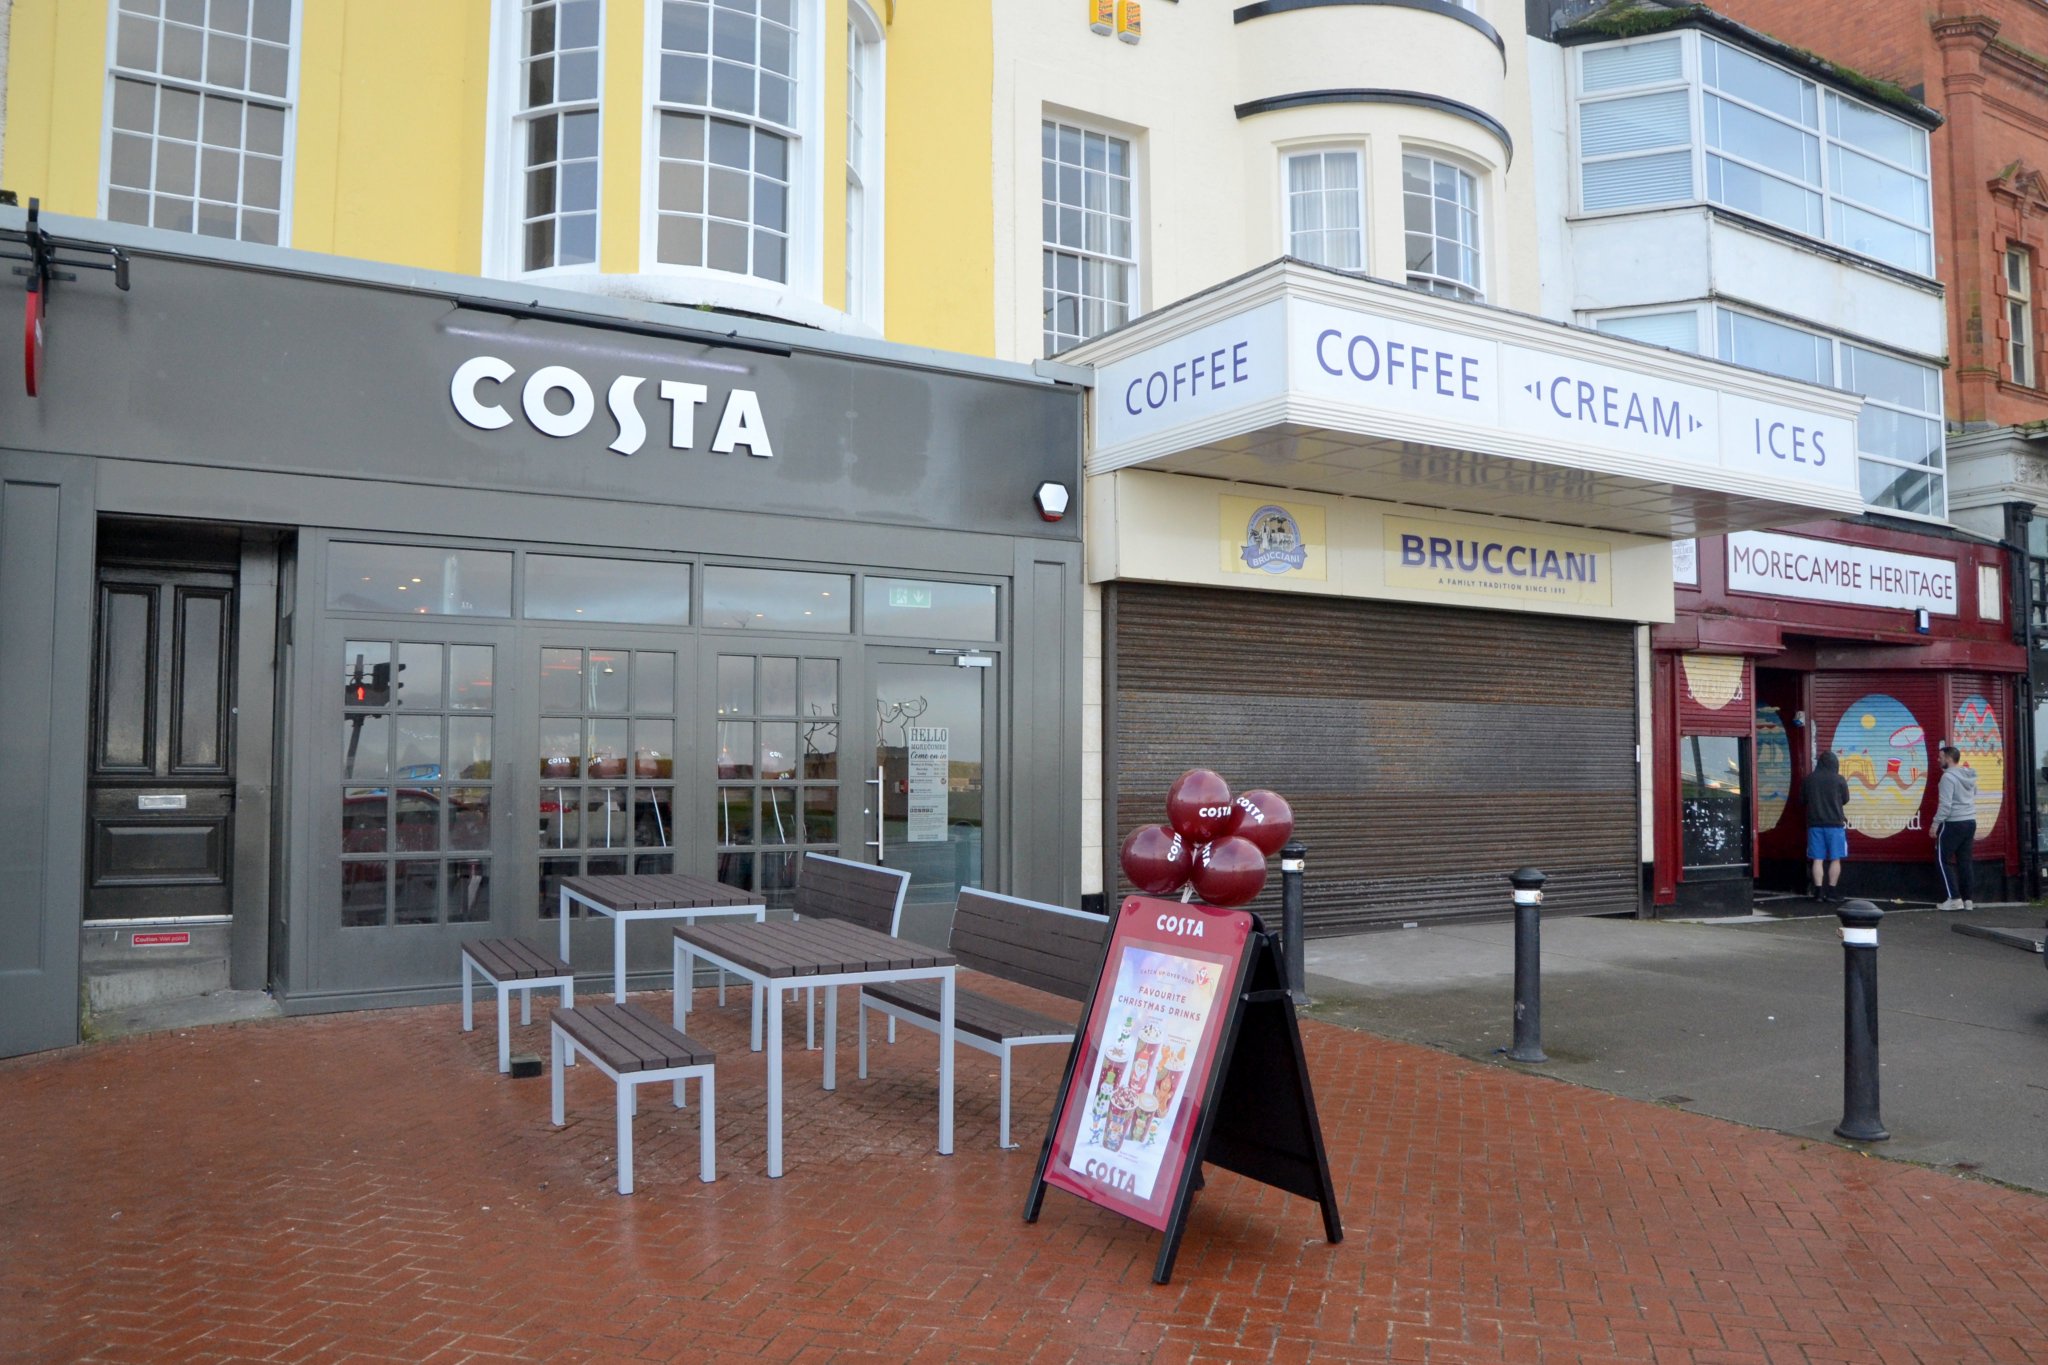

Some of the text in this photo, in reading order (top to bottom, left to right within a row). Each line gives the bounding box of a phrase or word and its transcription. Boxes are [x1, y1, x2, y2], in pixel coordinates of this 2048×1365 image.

[1125, 341, 1249, 416] COFFEE
[451, 355, 774, 456] COSTA
[1316, 328, 1826, 467] COFFEE CREAM ICES
[1252, 551, 1300, 567] BRUCCIANI
[1401, 533, 1598, 583] BRUCCIANI
[1447, 578, 1475, 587] FAMILY
[1479, 581, 1522, 591] TRADITION
[1525, 585, 1548, 593] SINCE
[1733, 545, 1862, 589] MORECAMBE
[1869, 564, 1953, 600] HERITAGE
[911, 728, 947, 742] HELLO
[548, 757, 571, 765] COSTA
[1199, 806, 1232, 818] COSTA
[1236, 796, 1265, 824] COSTA
[1156, 914, 1204, 937] COSTA
[1118, 995, 1165, 1013] CHRISTMAS
[1168, 1007, 1201, 1022] DRINKS
[1139, 986, 1187, 1004] FAVOURITE
[1085, 1158, 1136, 1194] COSTA
